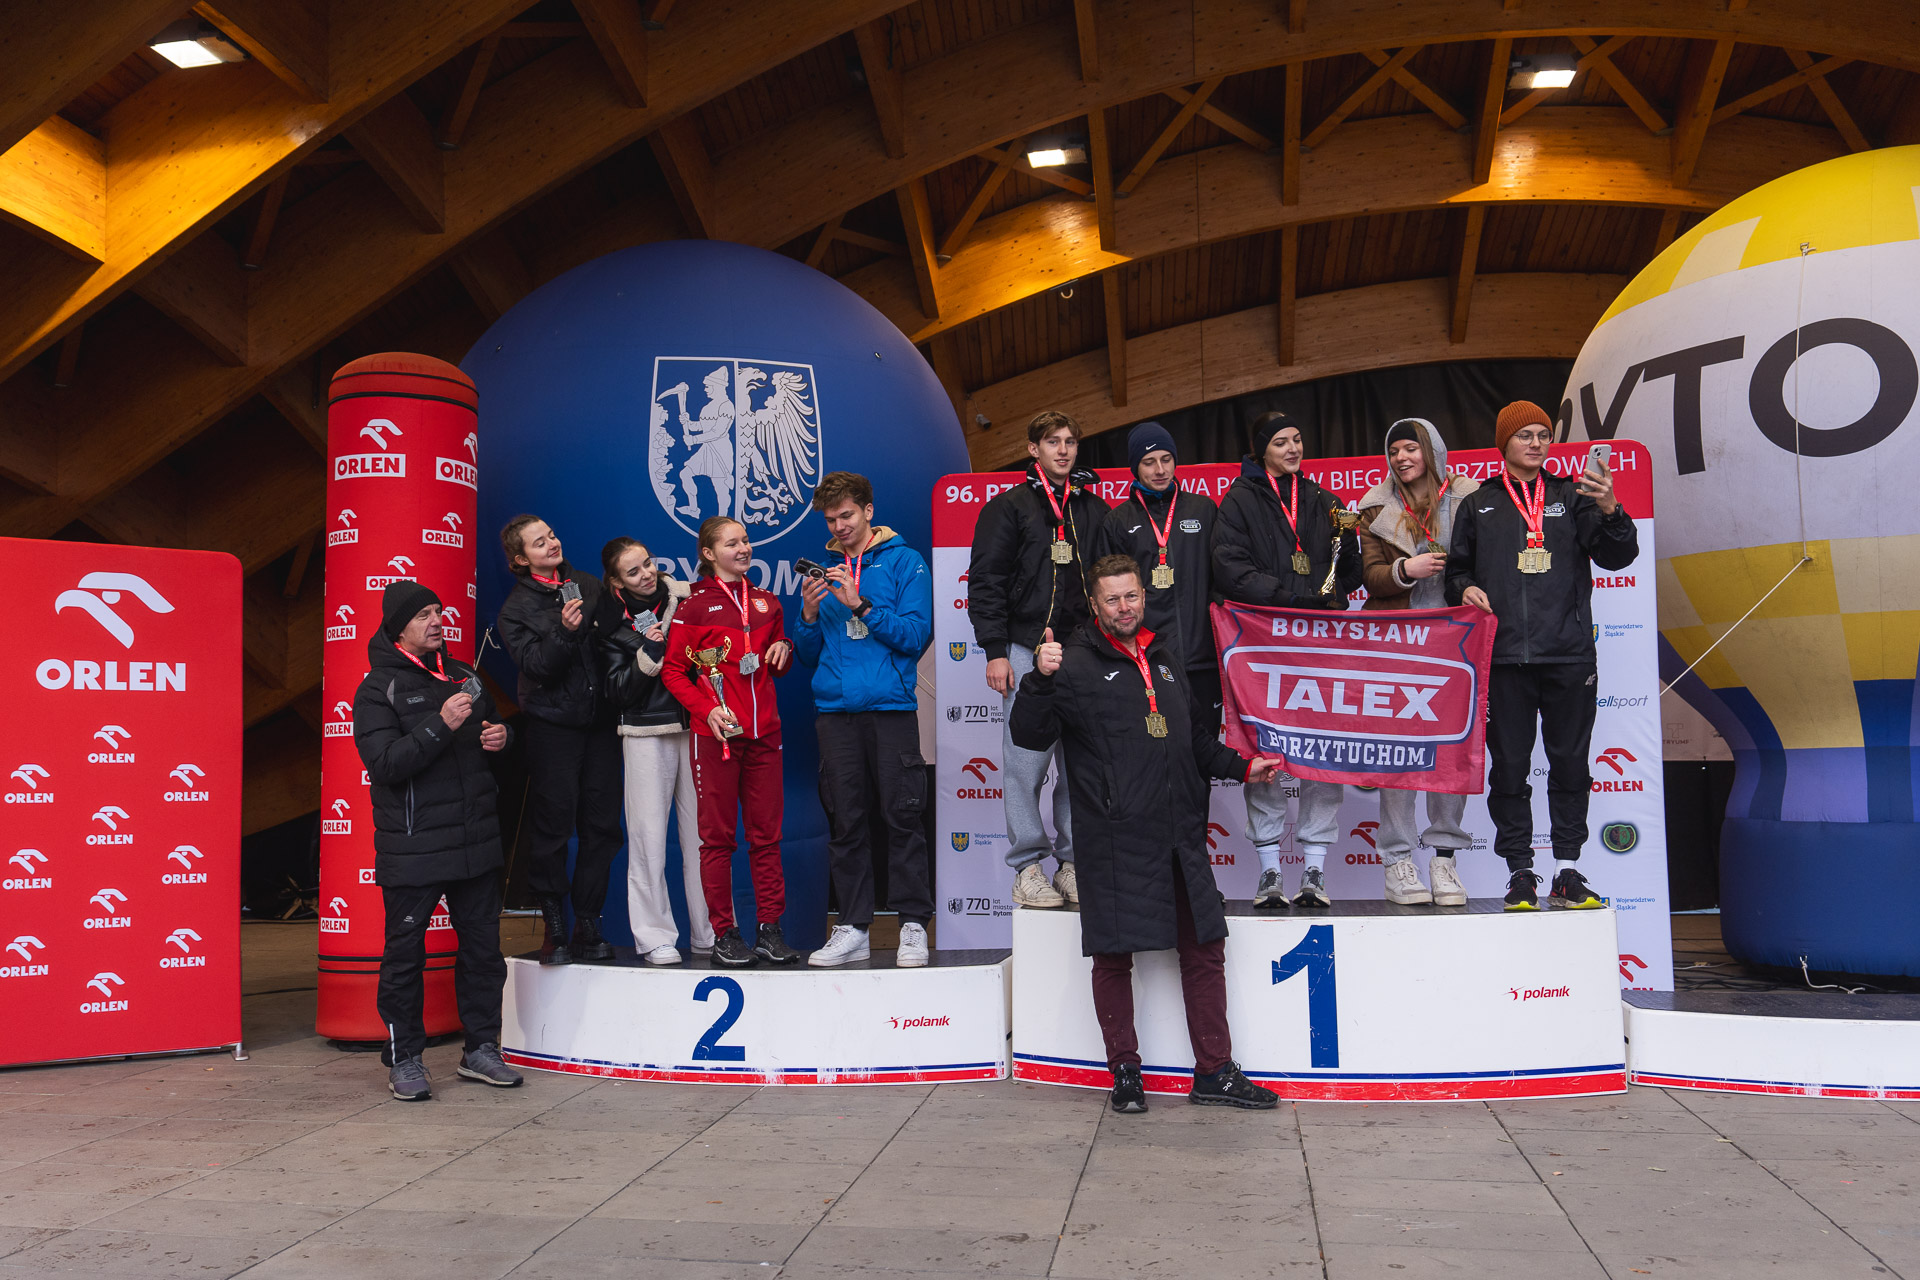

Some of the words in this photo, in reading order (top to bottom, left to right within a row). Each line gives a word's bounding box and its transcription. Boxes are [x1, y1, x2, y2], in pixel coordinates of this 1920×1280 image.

[337, 456, 400, 476] ORLEN
[945, 485, 980, 503] 96.
[329, 531, 356, 544] ORLEN
[425, 531, 462, 546] ORLEN
[1272, 617, 1430, 646] BORYSŁAW
[1604, 623, 1643, 631] Województwo
[327, 627, 353, 640] ORLEN
[442, 629, 460, 640] LEN
[1604, 630, 1625, 638] Śląskie
[35, 658, 187, 692] ORLEN
[1247, 662, 1450, 722] TALEX
[965, 705, 988, 718] 770
[325, 723, 351, 736] ORLEN
[88, 752, 135, 764] ORLEN
[1591, 780, 1643, 793] ORLEN
[4, 792, 54, 804] ORLEN
[163, 791, 209, 802] ORLEN
[957, 788, 1002, 800] ORLEN
[323, 821, 349, 833] ORLEN
[86, 834, 134, 845] ORLEN
[1209, 854, 1235, 866] LEN
[1344, 854, 1382, 865] ORLE
[2, 878, 52, 890] ORLEN
[162, 873, 208, 885] ORLEN
[966, 898, 990, 911] 770
[1616, 903, 1637, 911] Śląskie
[83, 917, 131, 929] ORLEN
[321, 920, 347, 931] ORLEN
[429, 916, 451, 928] RLE
[159, 956, 206, 968] ORLEN
[0, 964, 48, 978] ORLEN
[1272, 924, 1340, 1069] 1
[1523, 985, 1571, 1001] polanik
[80, 1000, 129, 1013] ORLEN
[691, 975, 746, 1062] 2
[903, 1015, 951, 1030] polanik
